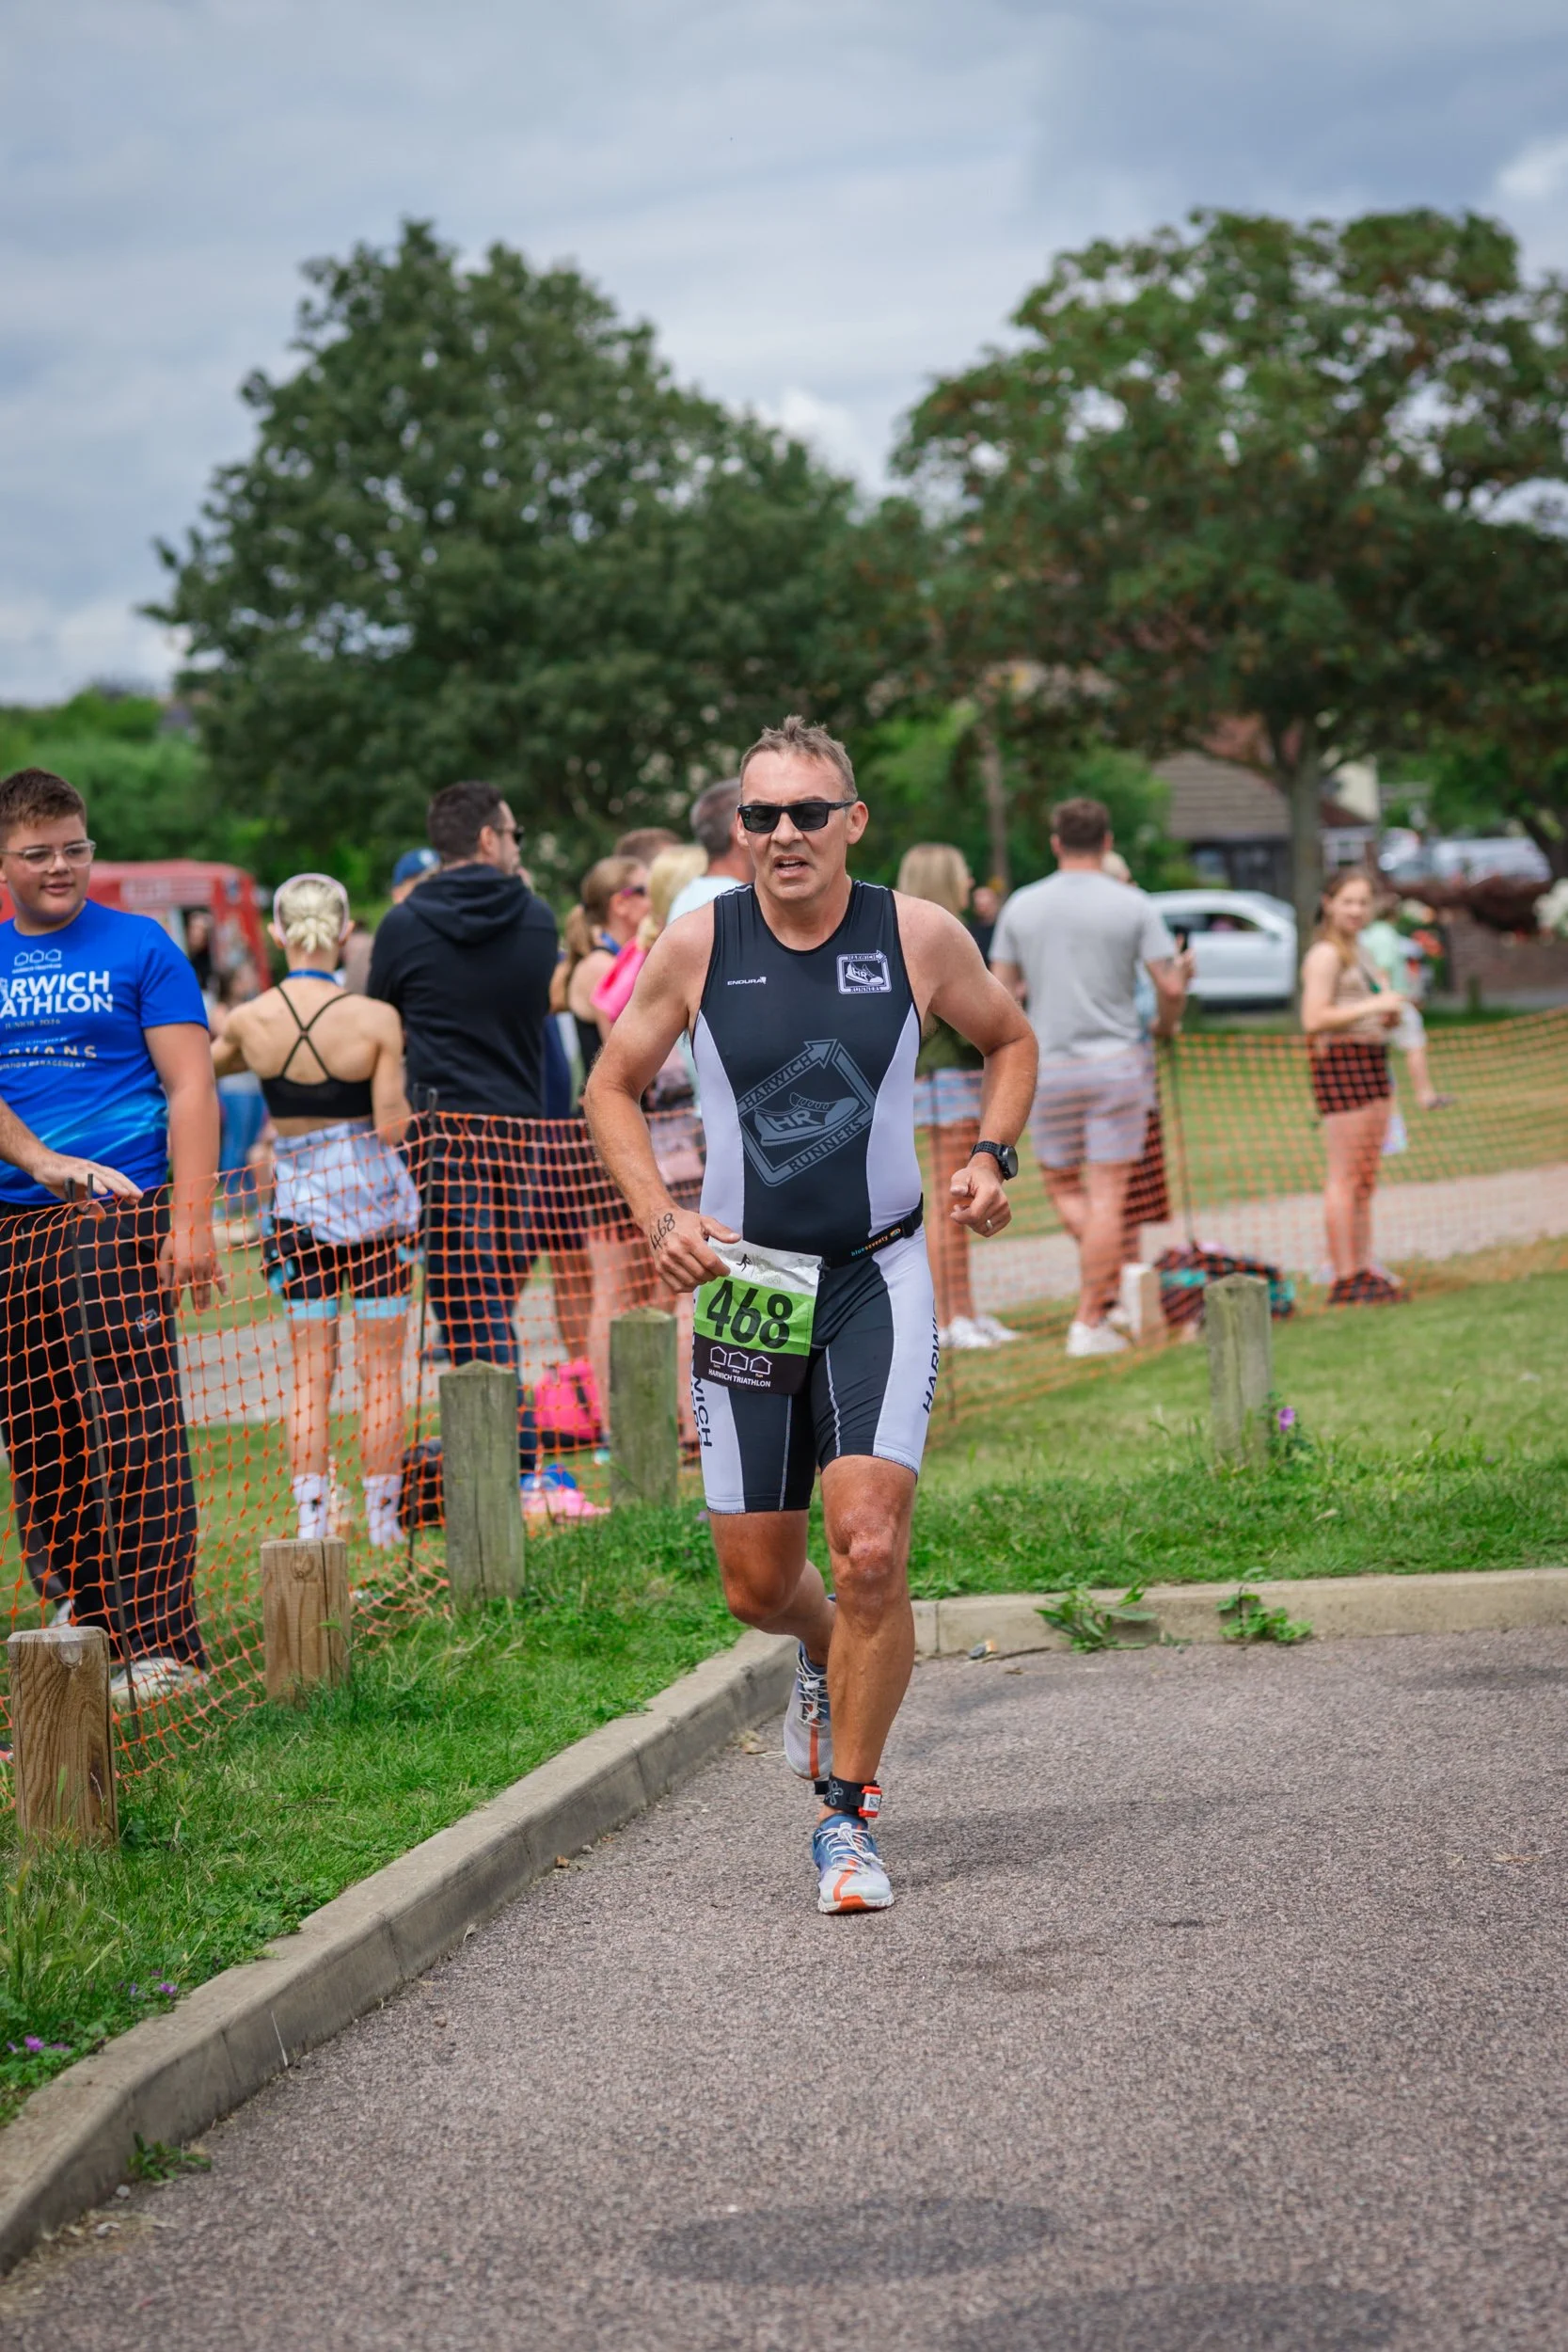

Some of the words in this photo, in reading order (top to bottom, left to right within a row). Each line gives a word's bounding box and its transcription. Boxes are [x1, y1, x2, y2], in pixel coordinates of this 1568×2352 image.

[727, 977, 763, 986] ENDURA
[743, 1054, 814, 1108] HARWICH
[765, 1109, 824, 1131] HR
[789, 1120, 863, 1173] RUNNERS
[649, 1213, 675, 1250] 468
[706, 1279, 793, 1349] 468
[708, 1368, 732, 1381] HARWICH
[733, 1375, 771, 1388] TRIATHLON
